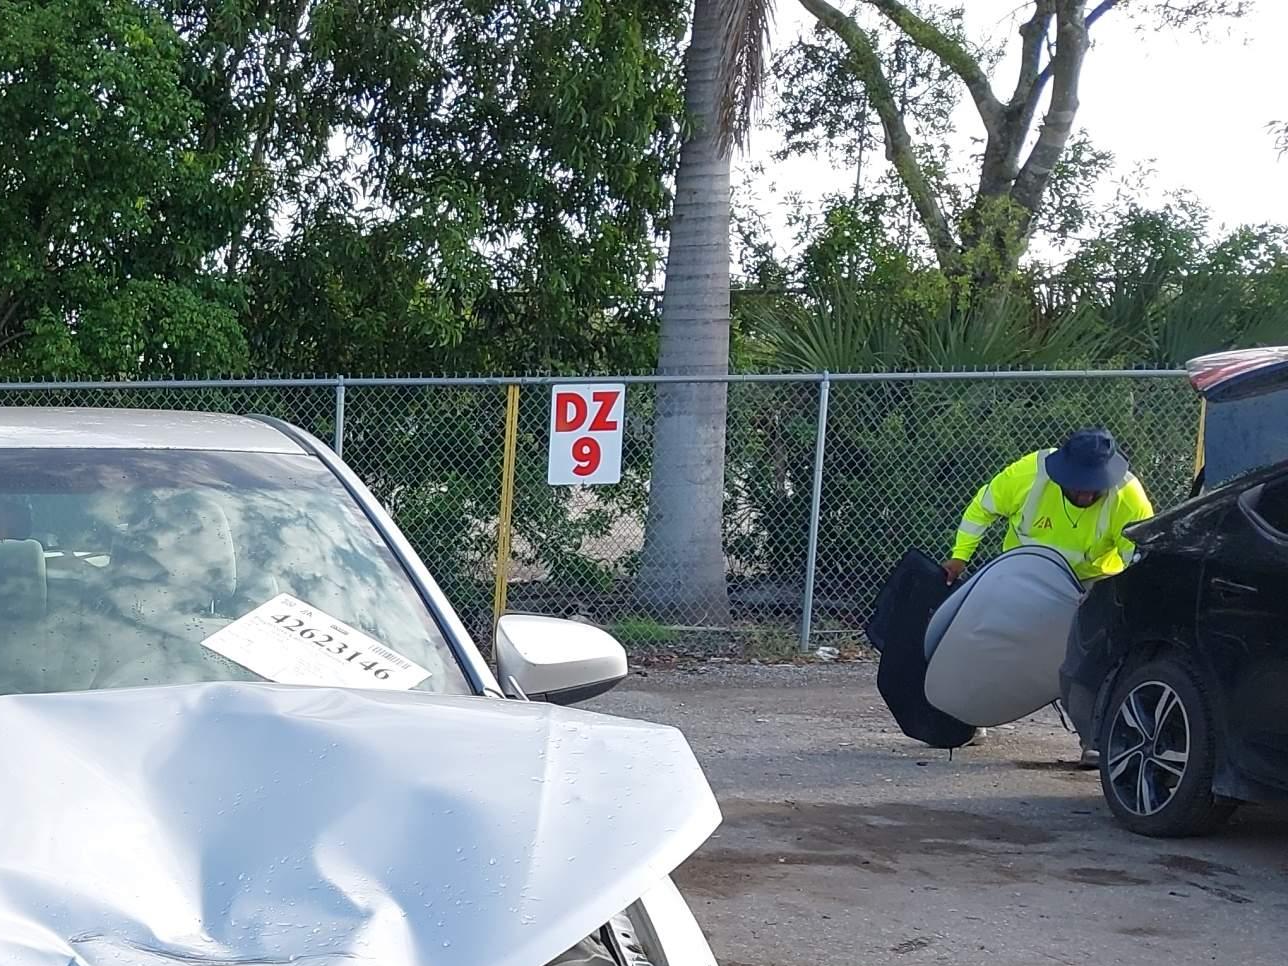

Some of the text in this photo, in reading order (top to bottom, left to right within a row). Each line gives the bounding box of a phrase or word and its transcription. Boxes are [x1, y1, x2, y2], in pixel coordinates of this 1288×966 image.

[555, 391, 620, 432] DZ
[572, 437, 601, 476] 9
[270, 612, 397, 680] 42623146
